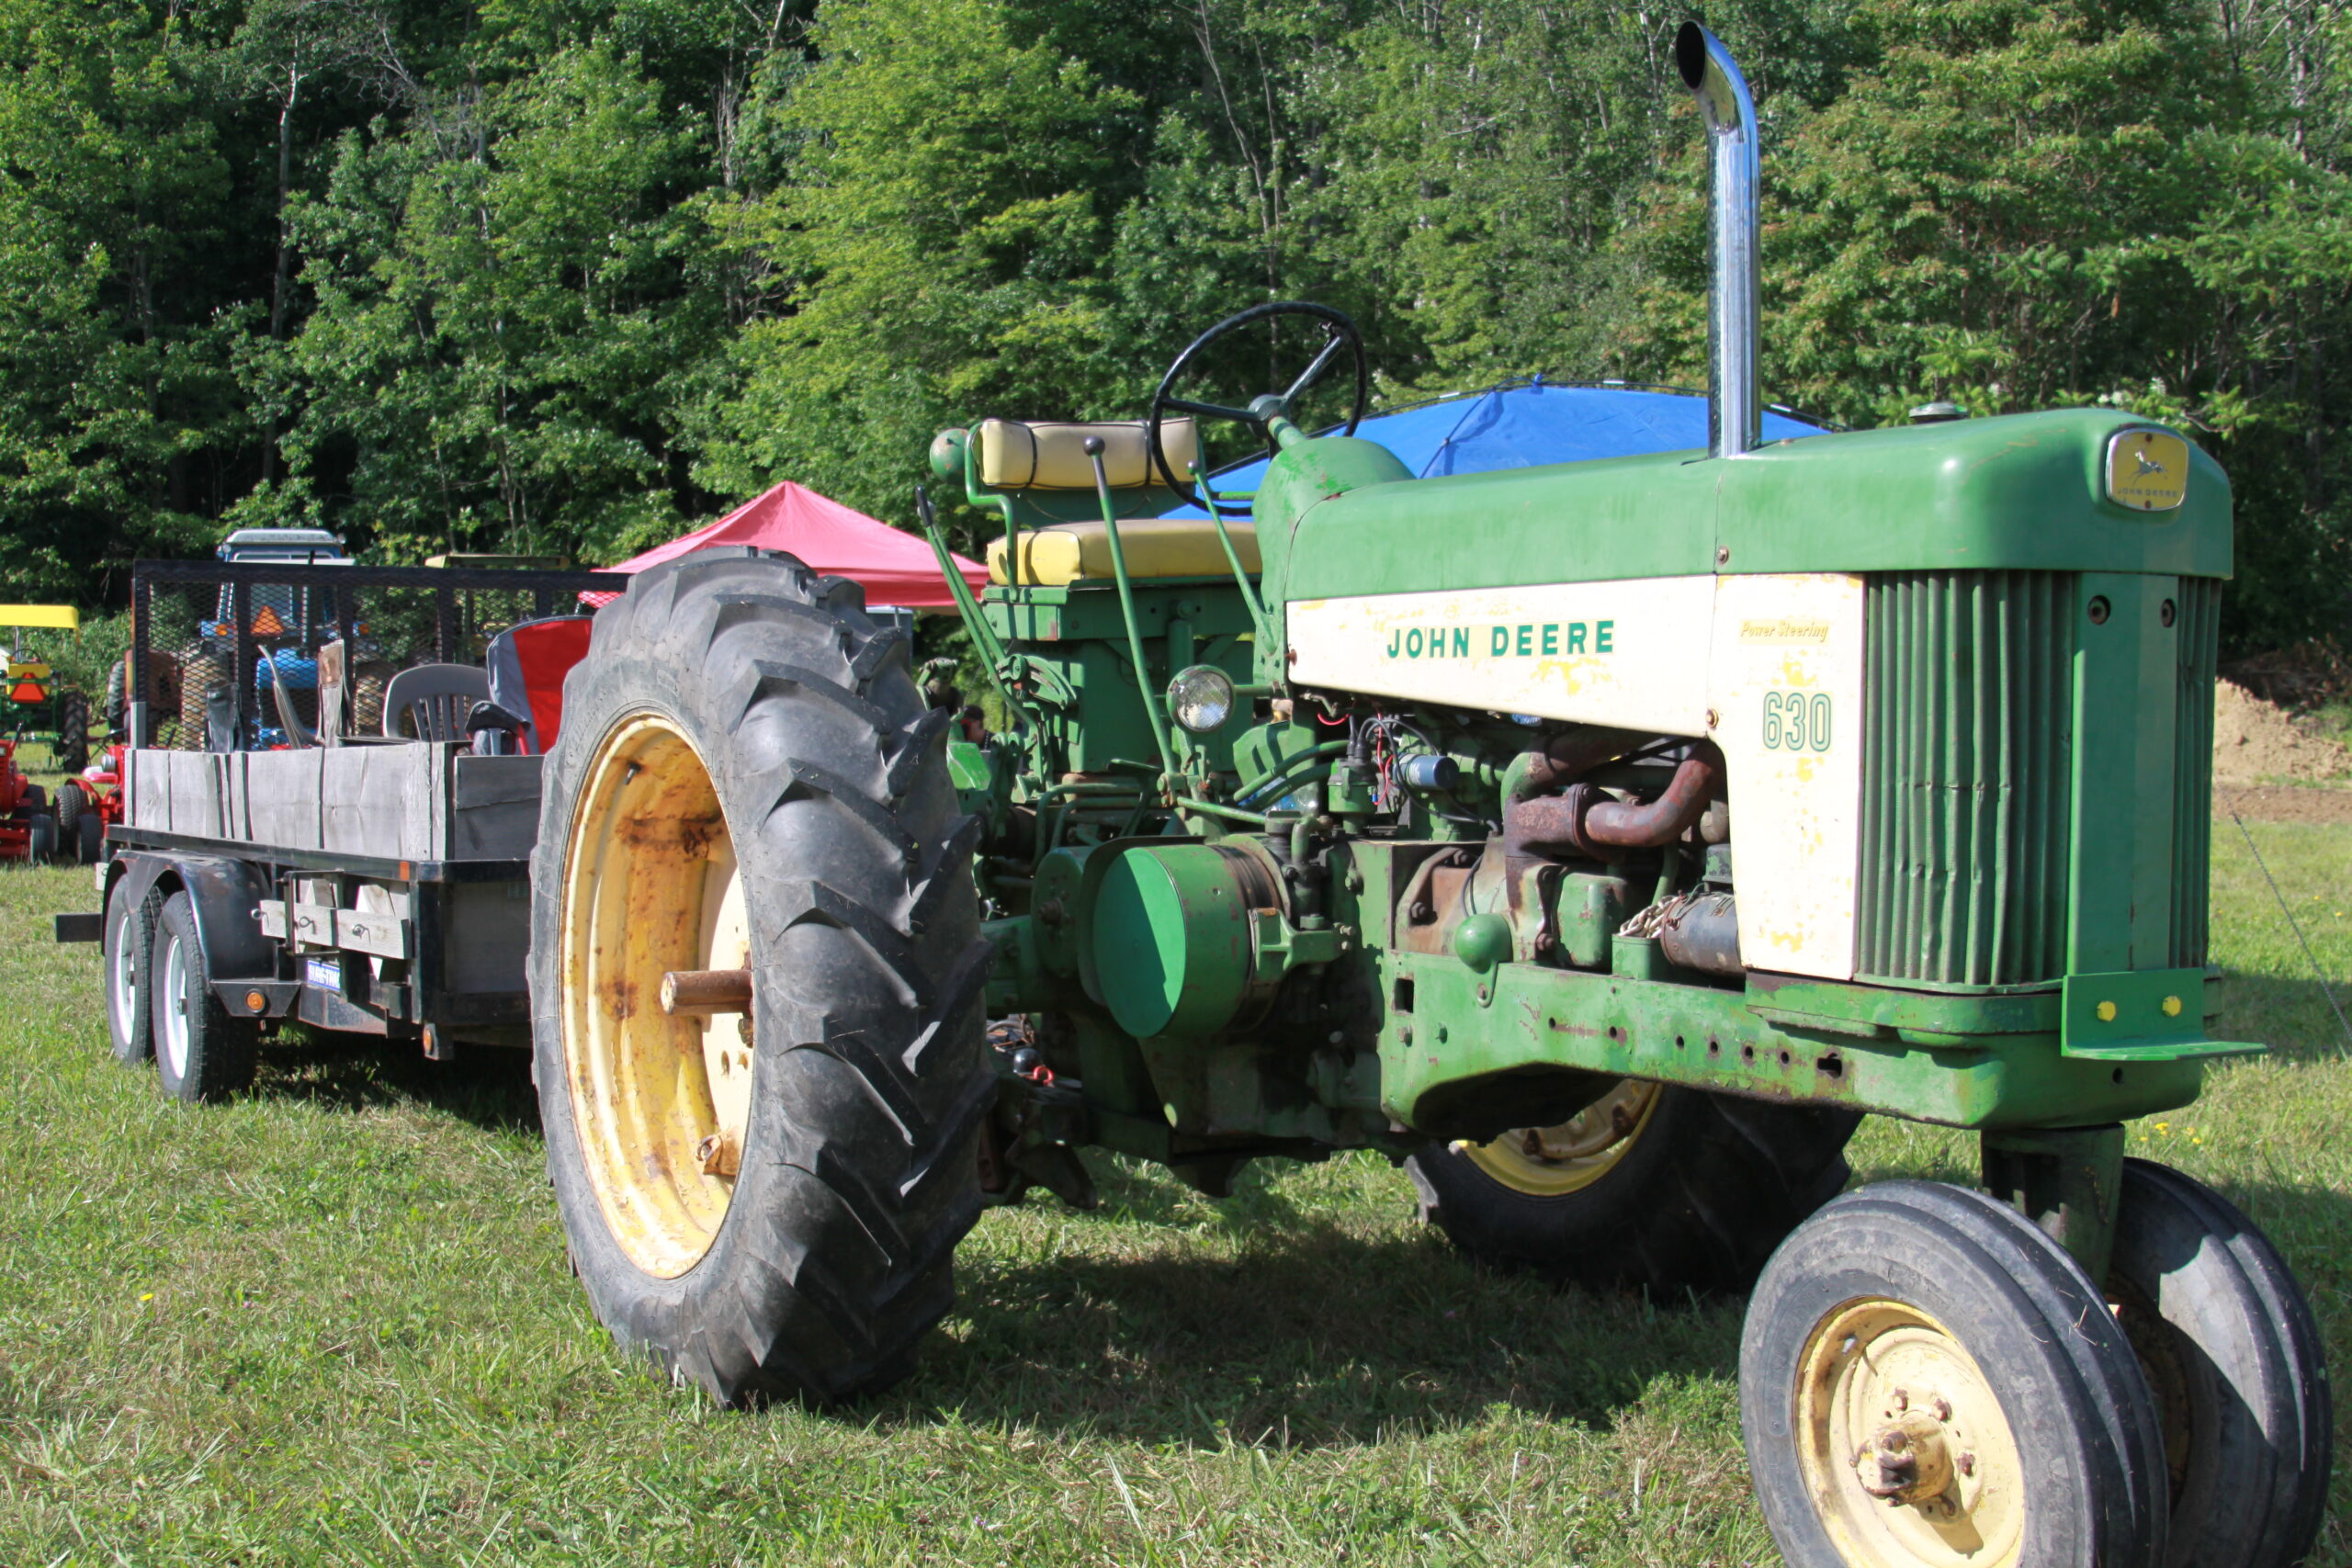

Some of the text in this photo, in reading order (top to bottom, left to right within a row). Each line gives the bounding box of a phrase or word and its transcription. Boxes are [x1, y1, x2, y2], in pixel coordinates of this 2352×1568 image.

[1386, 620, 1614, 659] JOHN DEERE
[1740, 619, 1829, 643] Power Steering
[1762, 691, 1832, 752] 630
